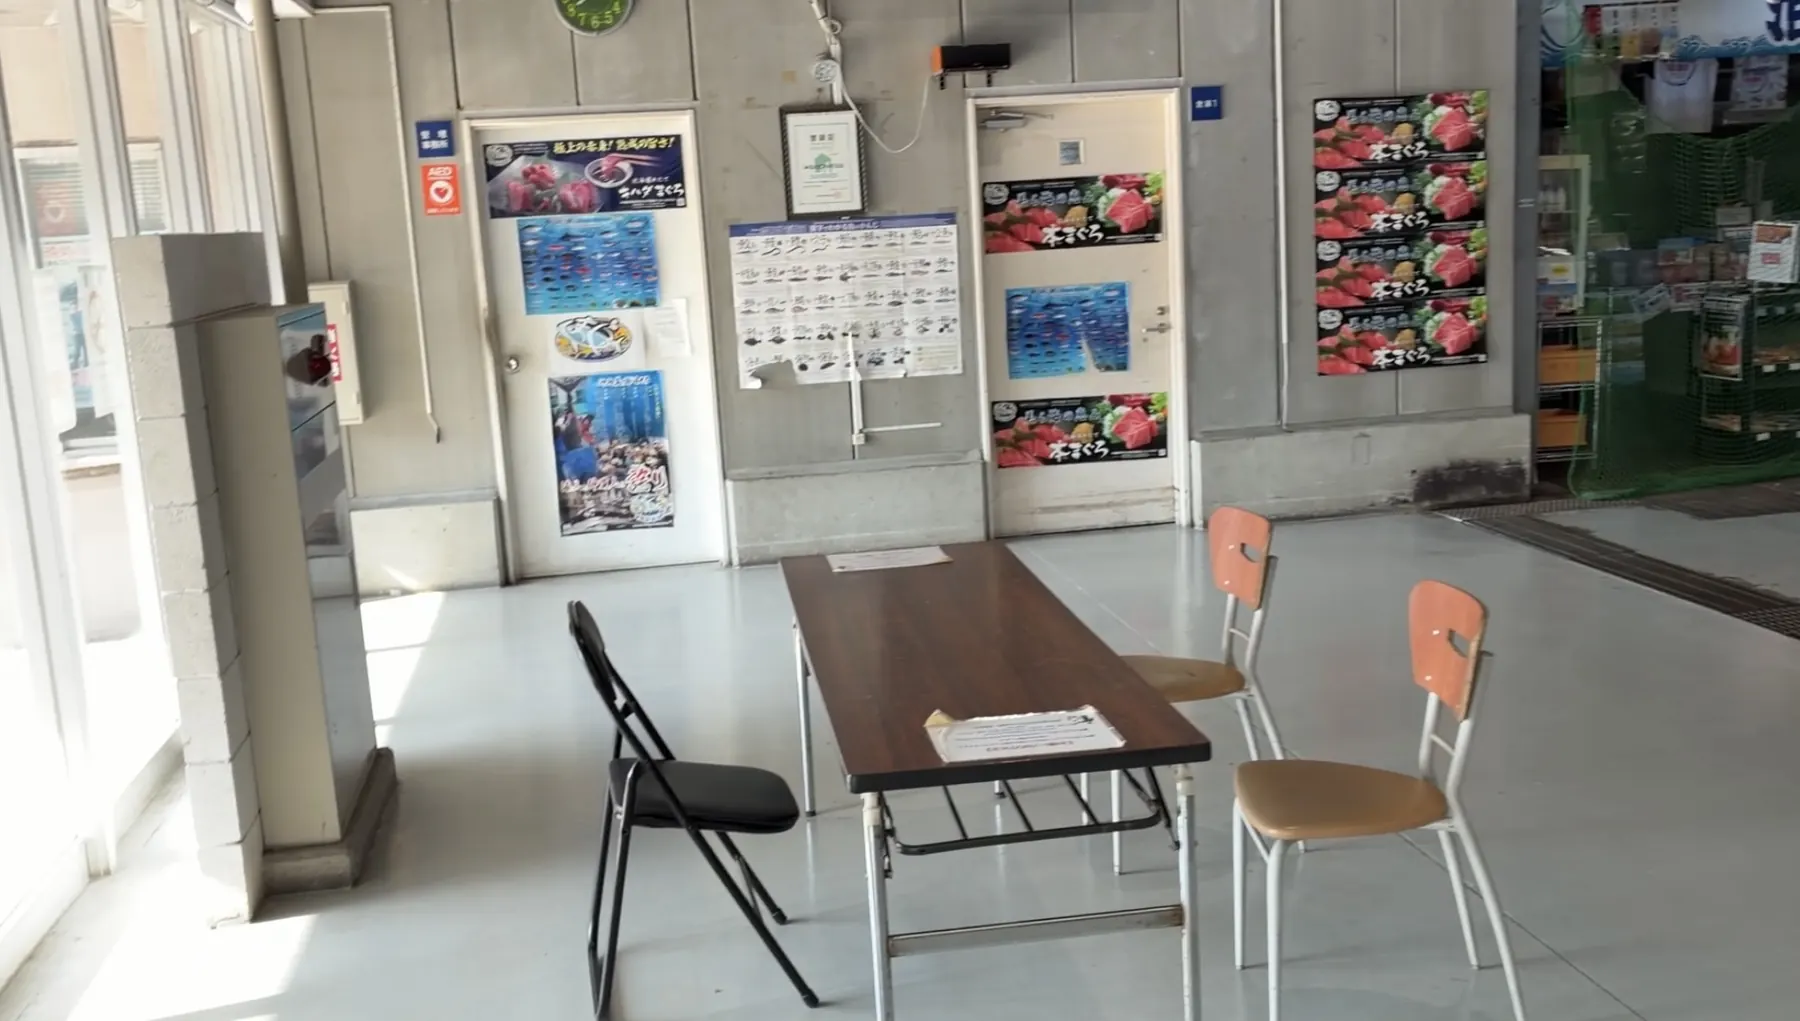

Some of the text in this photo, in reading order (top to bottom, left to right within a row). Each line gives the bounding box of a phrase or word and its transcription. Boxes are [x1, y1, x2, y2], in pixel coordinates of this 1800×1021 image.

[591, 15, 600, 29] 6
[1369, 141, 1429, 163] 本まぐろ
[1370, 211, 1430, 233] 本まぐろ
[1041, 223, 1104, 247] 本まぐろ
[1371, 279, 1430, 301] 本まぐろ
[1372, 347, 1431, 369] 本まぐろ
[1049, 440, 1109, 463] 本まぐろ
